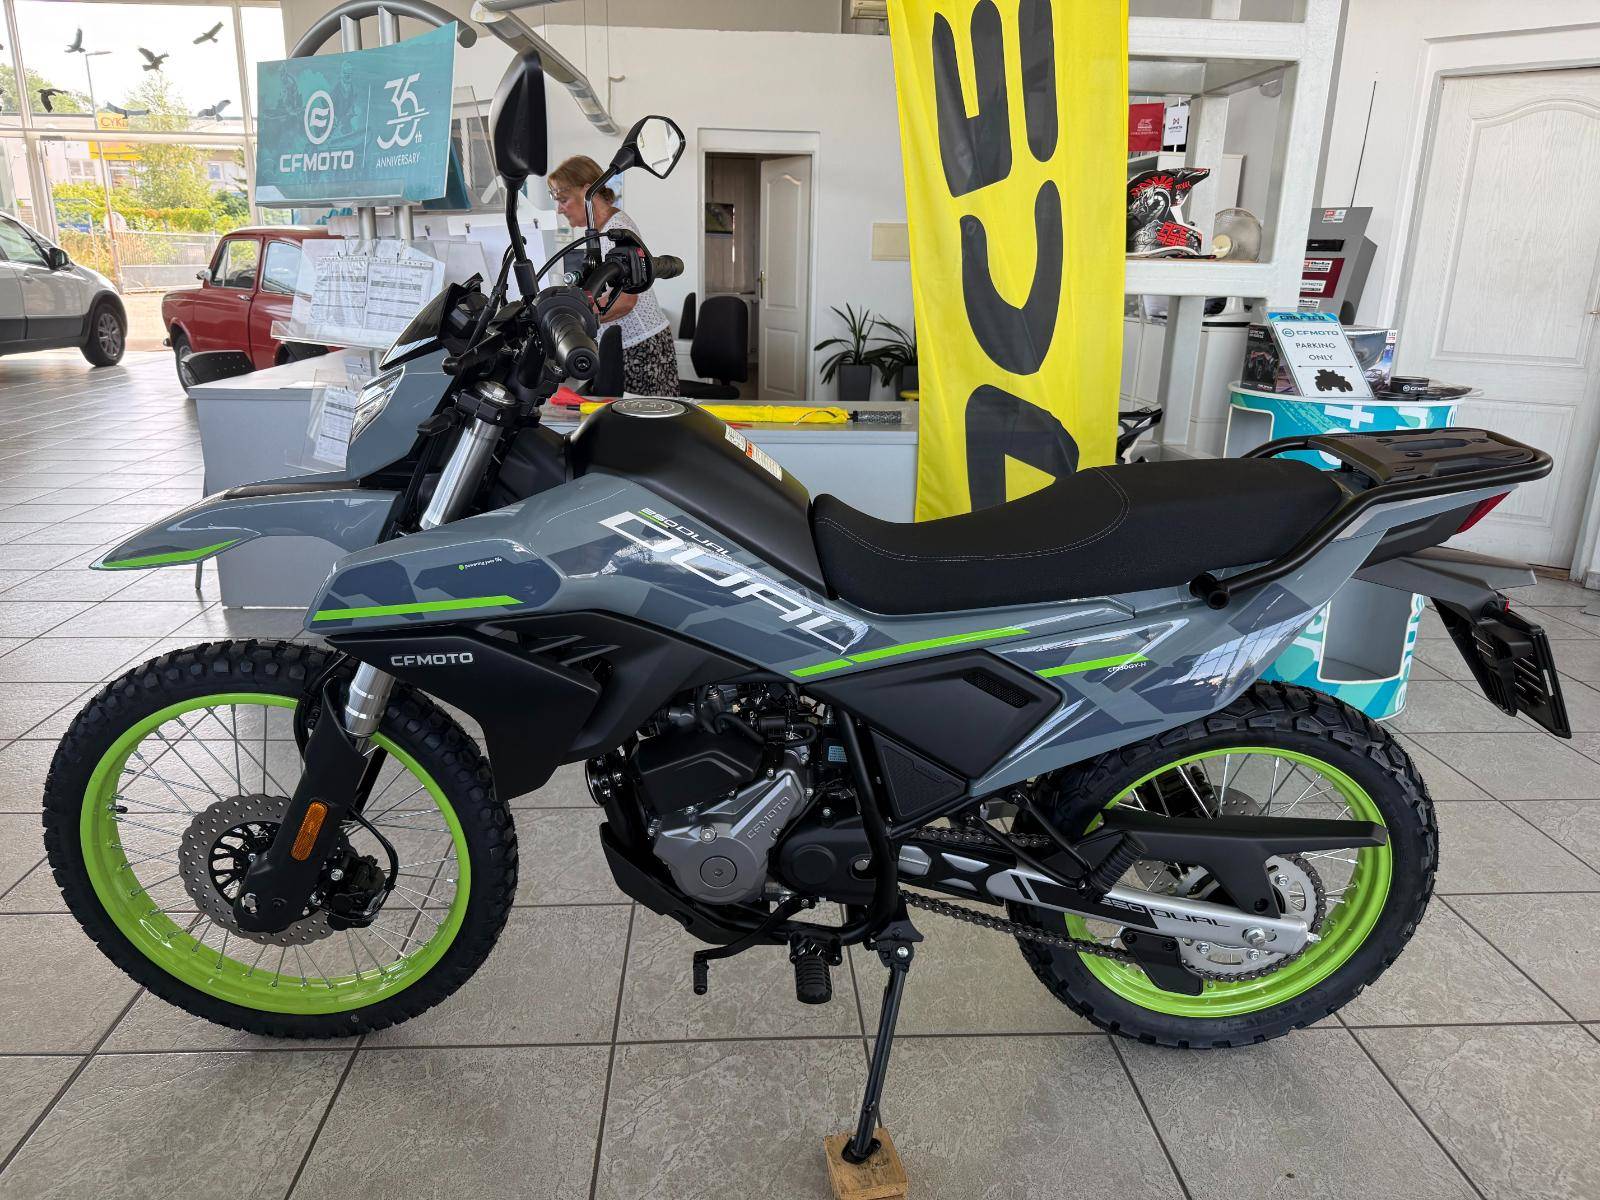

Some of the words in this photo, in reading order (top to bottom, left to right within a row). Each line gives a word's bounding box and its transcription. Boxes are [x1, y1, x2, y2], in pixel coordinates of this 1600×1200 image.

[279, 150, 354, 173] CFMOTO
[375, 152, 420, 168] ANNIVERSARY
[598, 511, 847, 655] DUAL
[391, 652, 474, 666] CFMOTO
[747, 797, 790, 839] CFMOTO
[1150, 909, 1231, 929] DUAL
